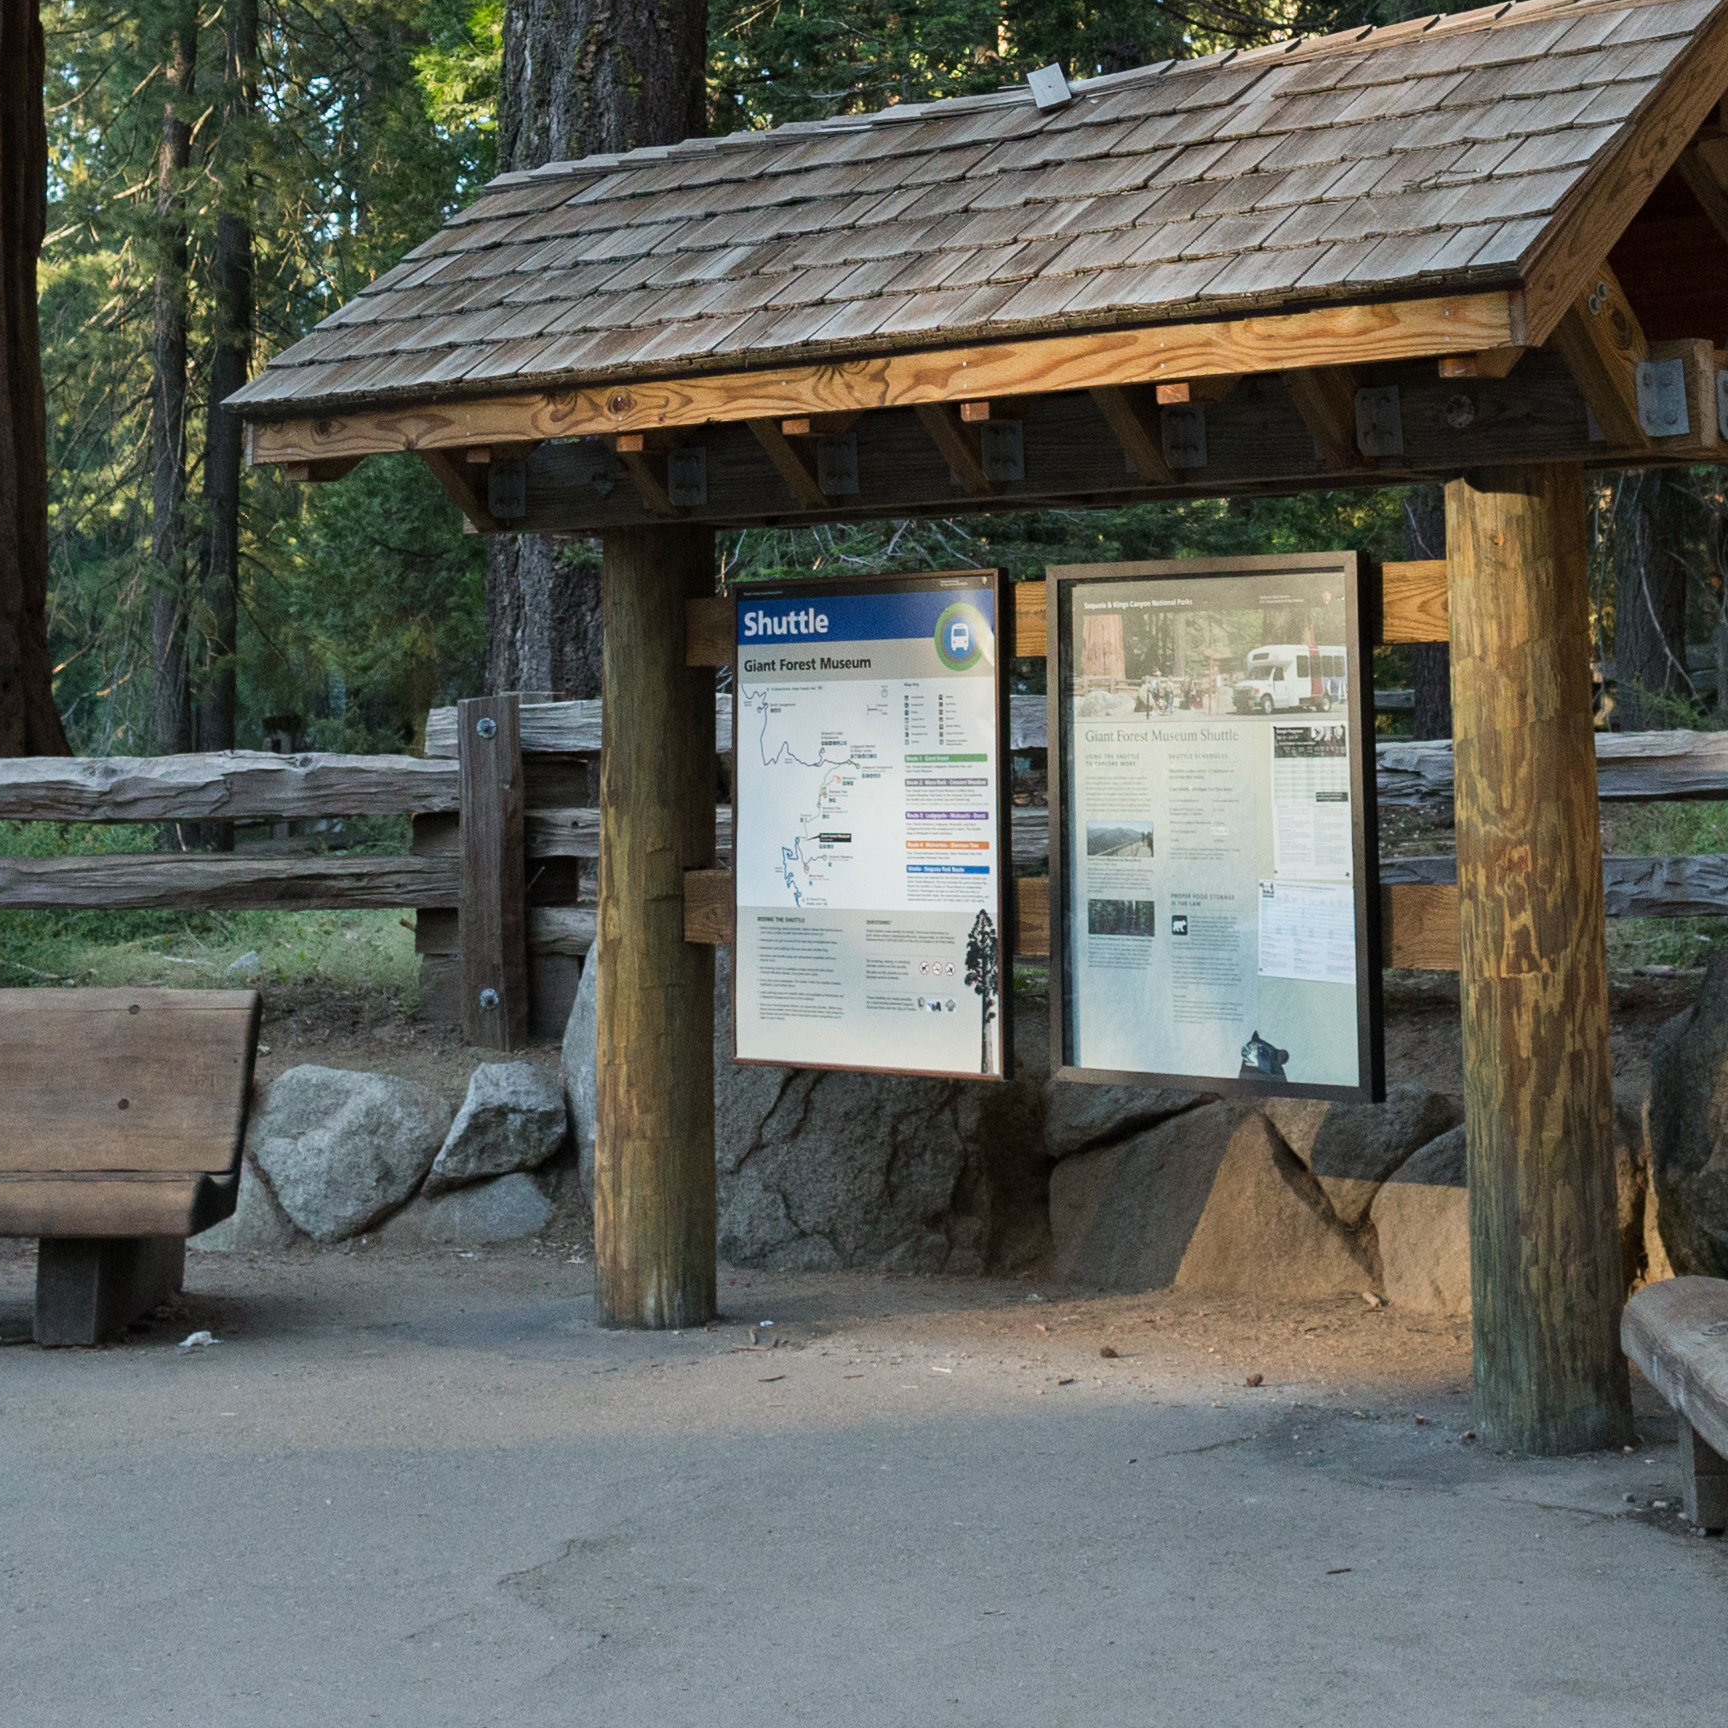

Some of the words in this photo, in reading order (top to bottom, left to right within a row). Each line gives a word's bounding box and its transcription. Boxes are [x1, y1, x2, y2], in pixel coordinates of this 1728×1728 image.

[744, 608, 829, 636] Shuttle
[744, 659, 776, 672] Giant
[780, 658, 816, 671] Forest
[820, 657, 871, 670] Museum
[1085, 730, 1114, 742] Giant
[1117, 729, 1148, 742] Forest
[1151, 729, 1198, 741] Museum
[1200, 728, 1239, 741] Shuttle
